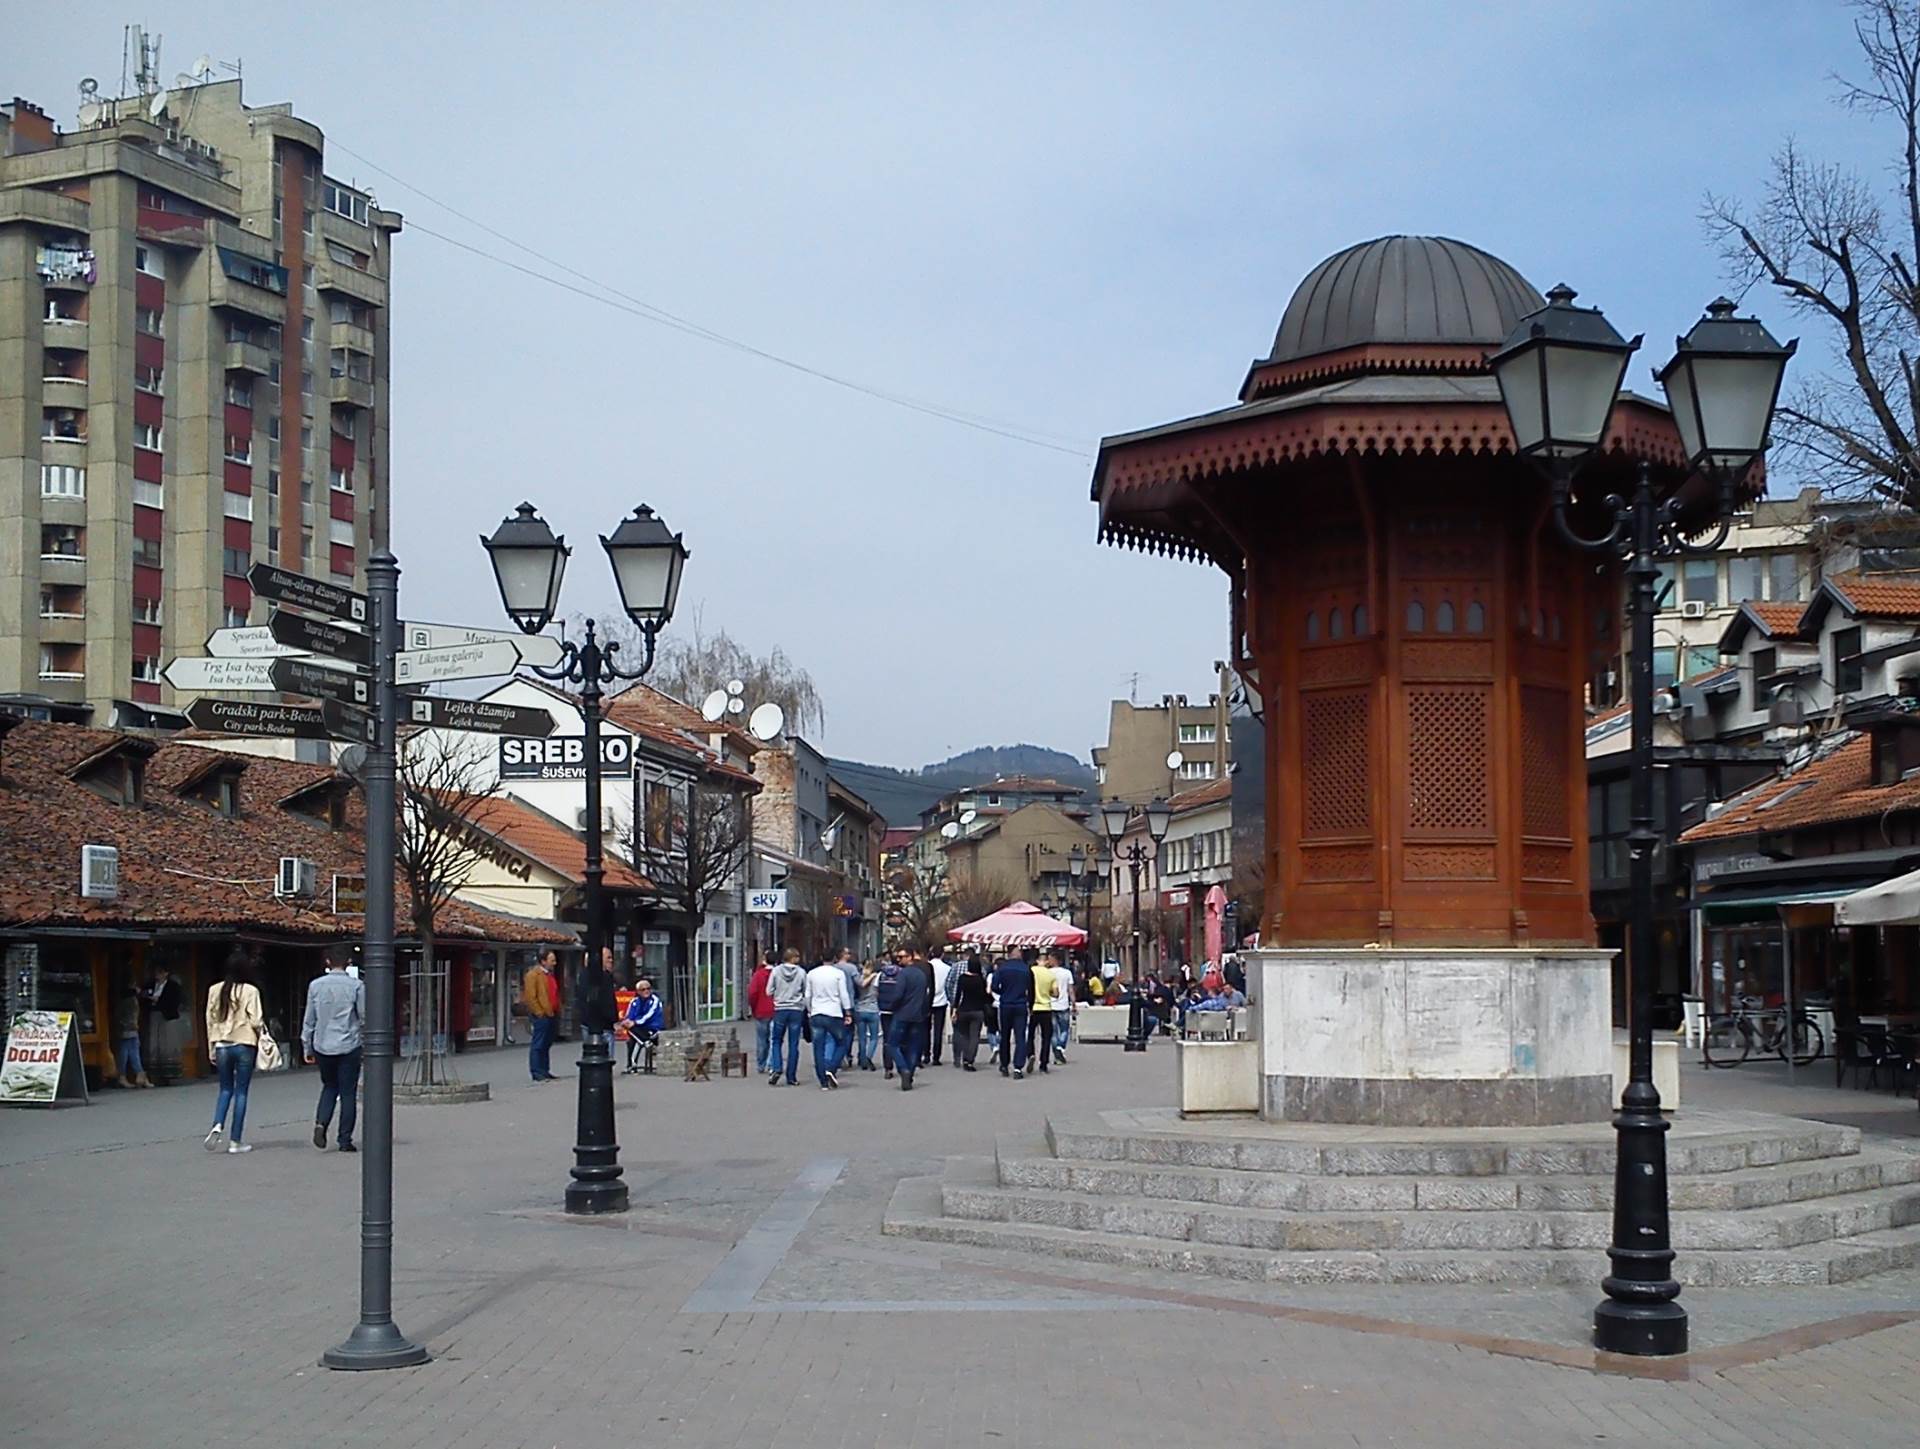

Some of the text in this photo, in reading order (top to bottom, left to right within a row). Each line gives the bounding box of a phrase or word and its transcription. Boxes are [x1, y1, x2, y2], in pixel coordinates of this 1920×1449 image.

[418, 649, 484, 665] Likovna galerija
[203, 661, 222, 674] Trg
[226, 661, 242, 672] Isa
[209, 675, 223, 684] Isa
[226, 674, 242, 685] beg
[211, 702, 257, 717] Gradski
[444, 701, 516, 720] Lejlek džamija
[224, 719, 295, 734] City park-Bedem
[449, 716, 472, 727] Lejlek
[752, 893, 778, 908] sky
[7, 1047, 60, 1063] DOLAR
